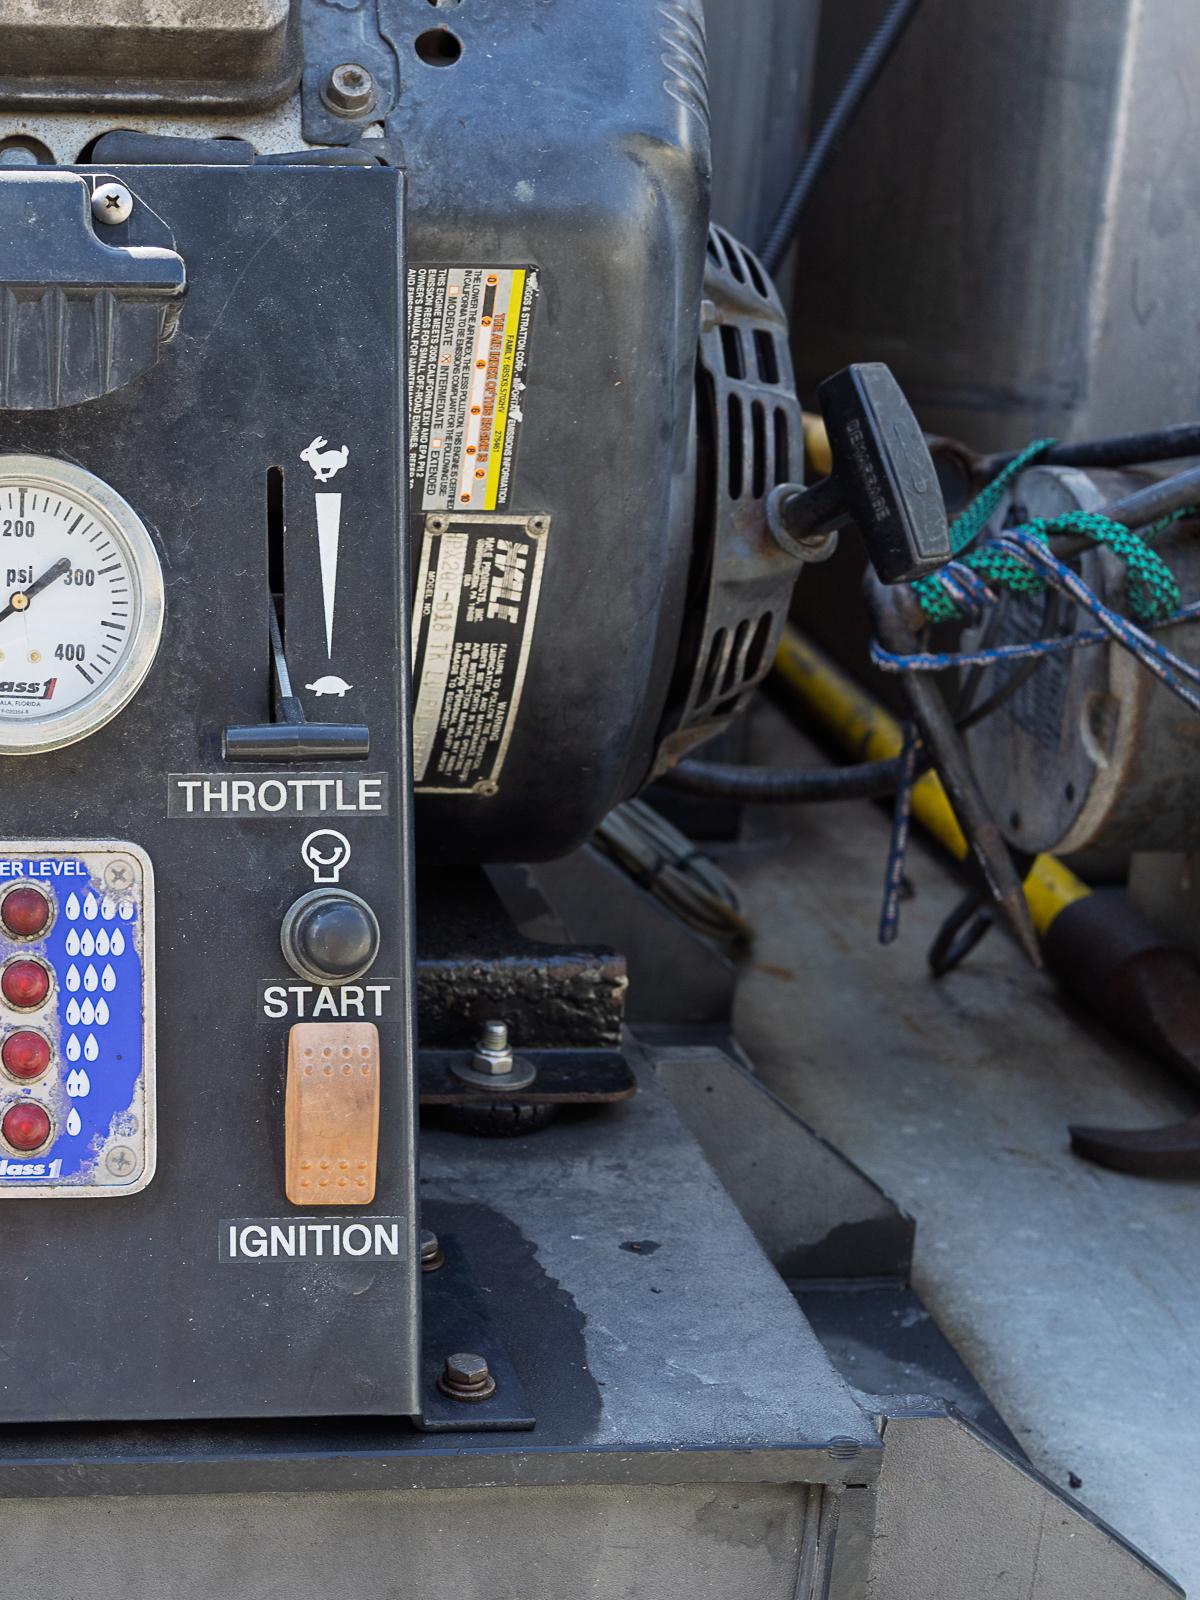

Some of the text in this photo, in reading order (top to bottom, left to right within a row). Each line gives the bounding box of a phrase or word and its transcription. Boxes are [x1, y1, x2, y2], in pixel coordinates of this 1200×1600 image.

[437, 269, 447, 286] THIS
[473, 270, 482, 283] THE
[434, 288, 445, 316] ENGINE
[459, 278, 471, 318] CALIFORNIA
[470, 285, 480, 308] LOWER
[409, 269, 427, 355] OWNER'S MANUAL FOR
[459, 319, 466, 327] TO
[468, 311, 477, 323] THE
[493, 313, 505, 331] THE
[431, 318, 442, 343] MEETS
[457, 329, 465, 337] BE
[467, 325, 475, 335] AIR
[517, 313, 529, 350] STRATTON
[490, 334, 502, 350] AIR
[504, 335, 514, 363] FAMILY:
[409, 269, 437, 449] EMISSION REGS FOR SMALL OFF-ROAD ENGINES.
[453, 339, 464, 374] EMISSIONS
[462, 359, 471, 372] THE
[487, 352, 500, 379] INDEX
[514, 352, 524, 372] CORP.
[423, 364, 437, 409] CALIFORNIA
[460, 373, 470, 389] LESS
[426, 297, 458, 495] MODERATE INTERMEDIATE EXTENDED
[448, 375, 459, 413] COMPLIANT
[509, 378, 521, 418] IMPORTA
[422, 411, 431, 425] EXH
[447, 415, 455, 427] FOR
[420, 428, 429, 443] AND
[445, 430, 453, 441] THE
[454, 431, 463, 445] THIS
[504, 419, 516, 456] EMISSIONS
[418, 445, 427, 459] EPA
[441, 443, 452, 480] FOLLOWING
[451, 447, 461, 470] ENGINE
[417, 461, 425, 471] PH
[498, 457, 511, 503] INFORMATION
[446, 478, 457, 509] CERTIFIED
[2, 519, 35, 538] 200
[6, 565, 34, 587] psi
[63, 569, 95, 587] 300
[485, 539, 530, 623] HALE
[422, 571, 436, 616] MODEL NO.
[54, 643, 86, 662] 400
[482, 643, 508, 734] FAILURE TO FOLLOW THE
[15, 700, 41, 708] FLORIDA
[489, 702, 507, 741] WARNING
[177, 780, 382, 812] THROTTLE
[28, 860, 86, 876] LEVEL
[264, 986, 390, 1019] START
[229, 1224, 399, 1258] IGNITION
